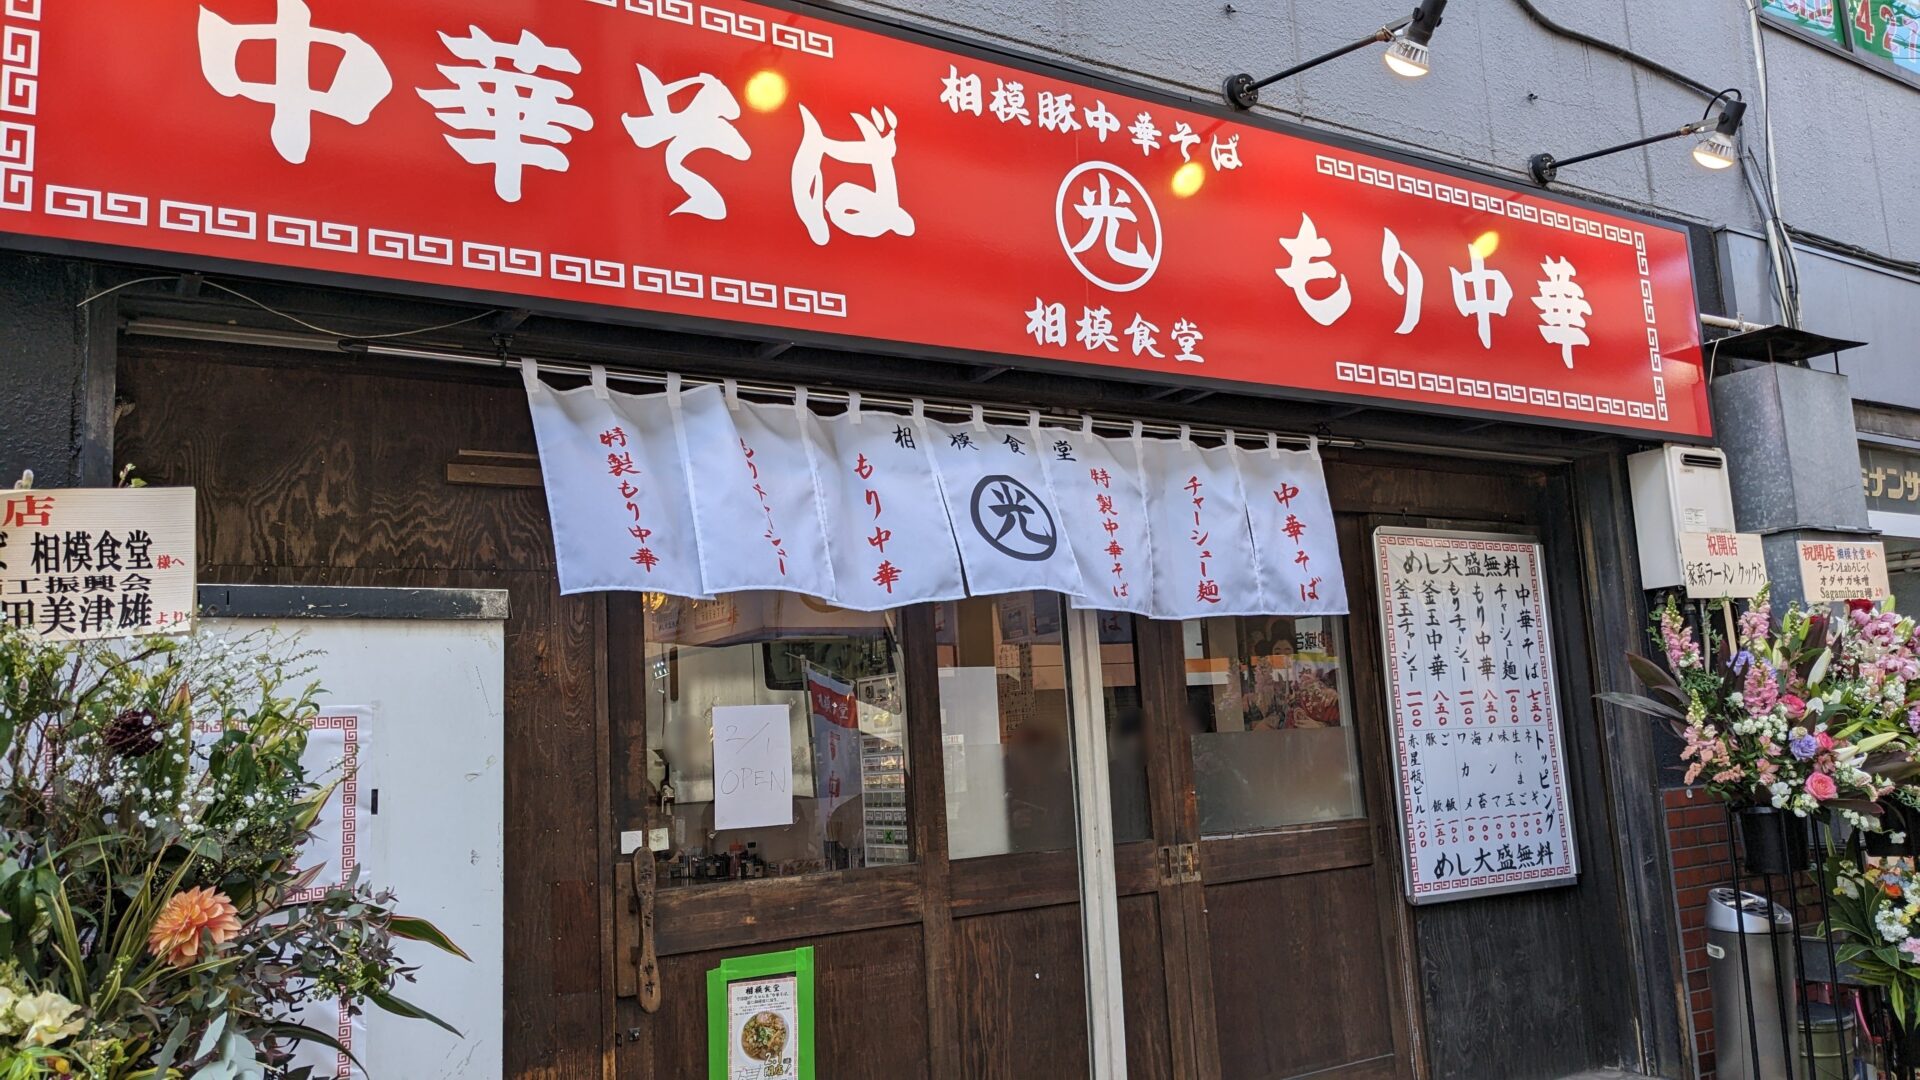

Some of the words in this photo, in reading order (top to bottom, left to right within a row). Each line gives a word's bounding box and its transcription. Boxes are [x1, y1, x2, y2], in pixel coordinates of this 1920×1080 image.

[197, 0, 917, 247] 中華そば
[940, 63, 1243, 173] 相模豚中華そば
[1071, 168, 1152, 272] 光
[1024, 296, 1206, 364] 相模食堂
[1275, 210, 1592, 370] もり中華
[892, 423, 1077, 463] 相模食堂
[600, 426, 660, 573] 特製もり中華
[854, 453, 902, 594] もり中華
[986, 480, 1055, 550] 光
[1090, 467, 1130, 599] 特製中華そば
[1183, 475, 1221, 603] チャーシュー麺
[1273, 482, 1323, 603] 中華そば
[1706, 534, 1738, 556] 祝開店
[0, 573, 152, 596] 工振興会
[30, 529, 154, 574] 相模食堂
[156, 554, 185, 570] 様へ
[1402, 551, 1521, 578] めし大盛無料
[1686, 560, 1735, 586] 家系ラーメン
[1802, 543, 1836, 561] 祝開店
[156, 610, 185, 625] より
[1394, 578, 1419, 682] 釜玉チャーシュー
[1419, 579, 1449, 682] 釜玉中華
[1448, 581, 1471, 682] もりチャーシュー
[1472, 581, 1496, 682] もり中華
[1494, 582, 1520, 681] チャーシュー麺
[1514, 583, 1540, 681] 中華そば
[720, 767, 786, 795] OPEN
[724, 721, 770, 754] 2/1
[1535, 729, 1556, 833] トッピング
[1433, 840, 1554, 880] めし大盛無料
